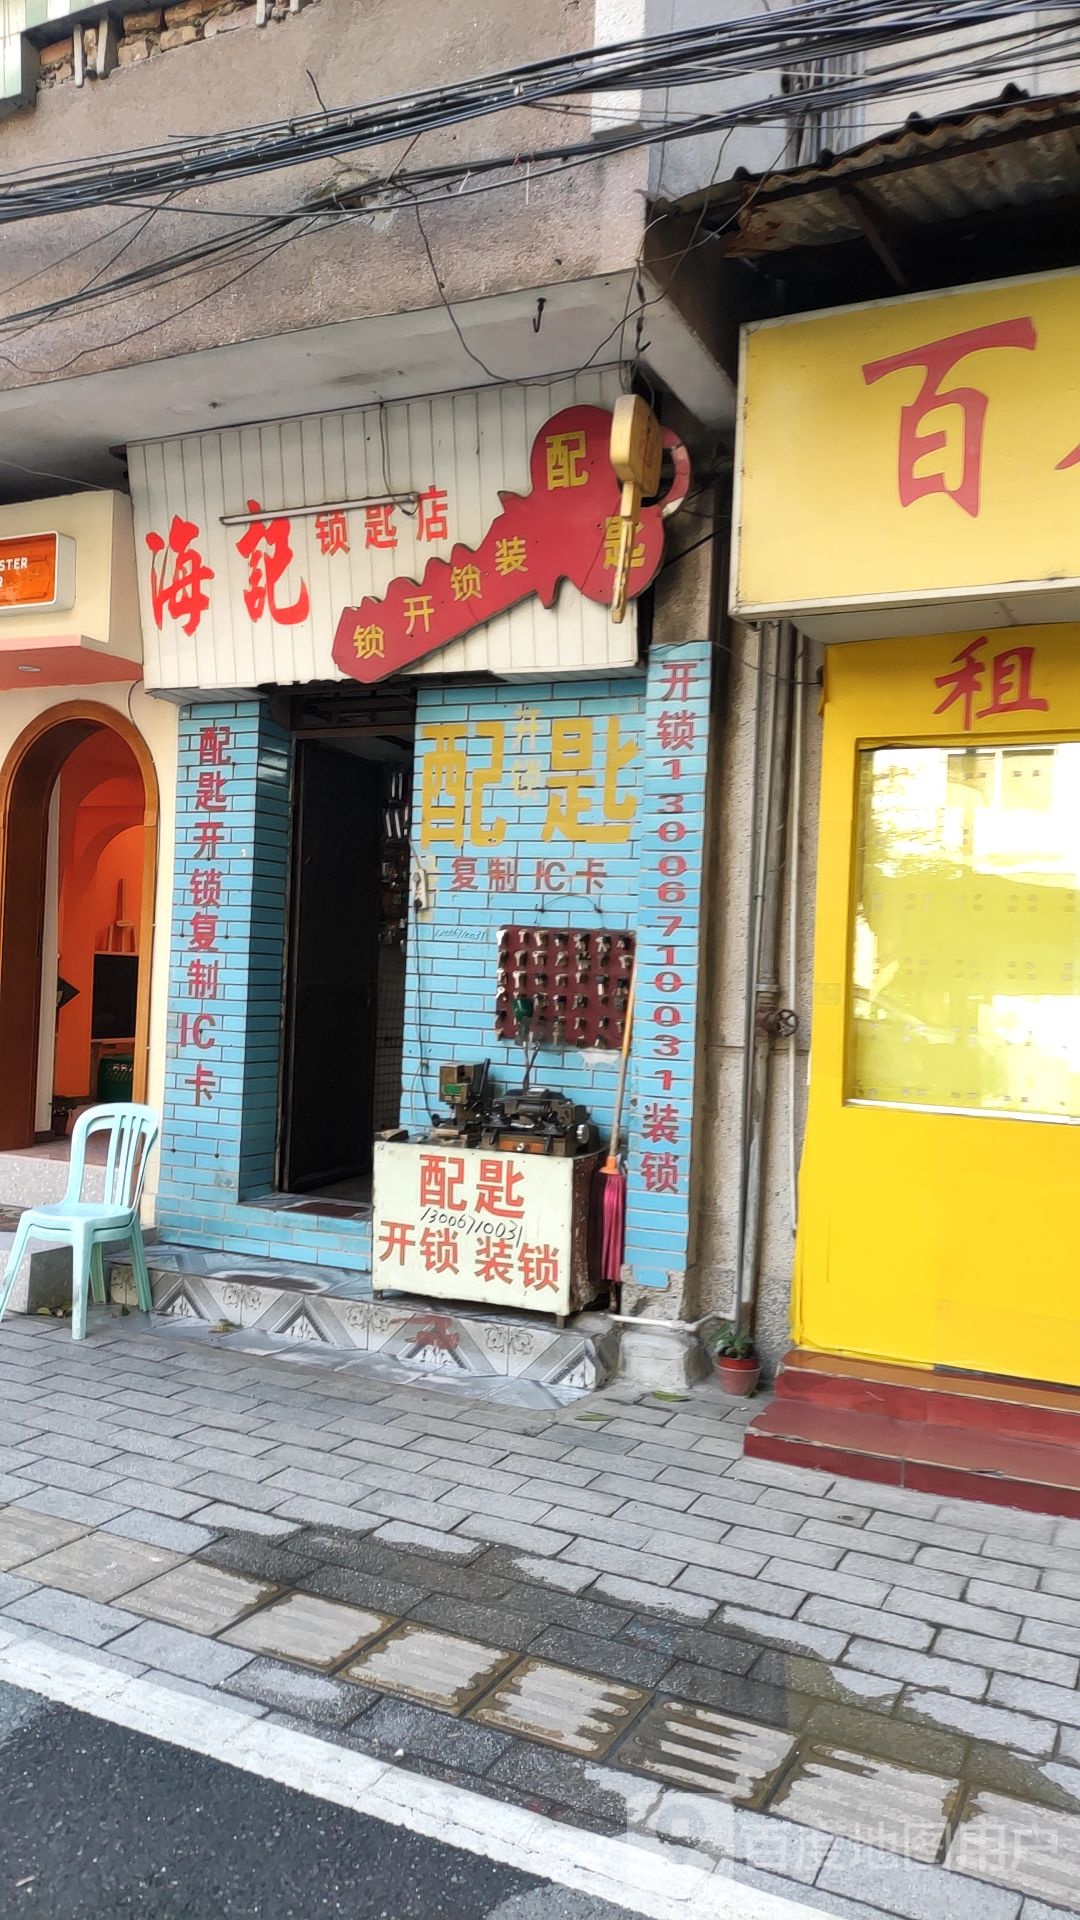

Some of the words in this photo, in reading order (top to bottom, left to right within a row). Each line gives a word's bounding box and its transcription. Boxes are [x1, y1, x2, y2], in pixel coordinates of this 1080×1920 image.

[862, 316, 1080, 518] 百
[314, 485, 448, 557] 锁匙店
[933, 636, 1049, 731] 租
[420, 714, 640, 850] 配匙
[419, 1154, 526, 1219] 配匙
[379, 1220, 460, 1275] 开锁
[475, 1235, 561, 1294] 装锁
[420, 1206, 523, 1248] 13006710031
